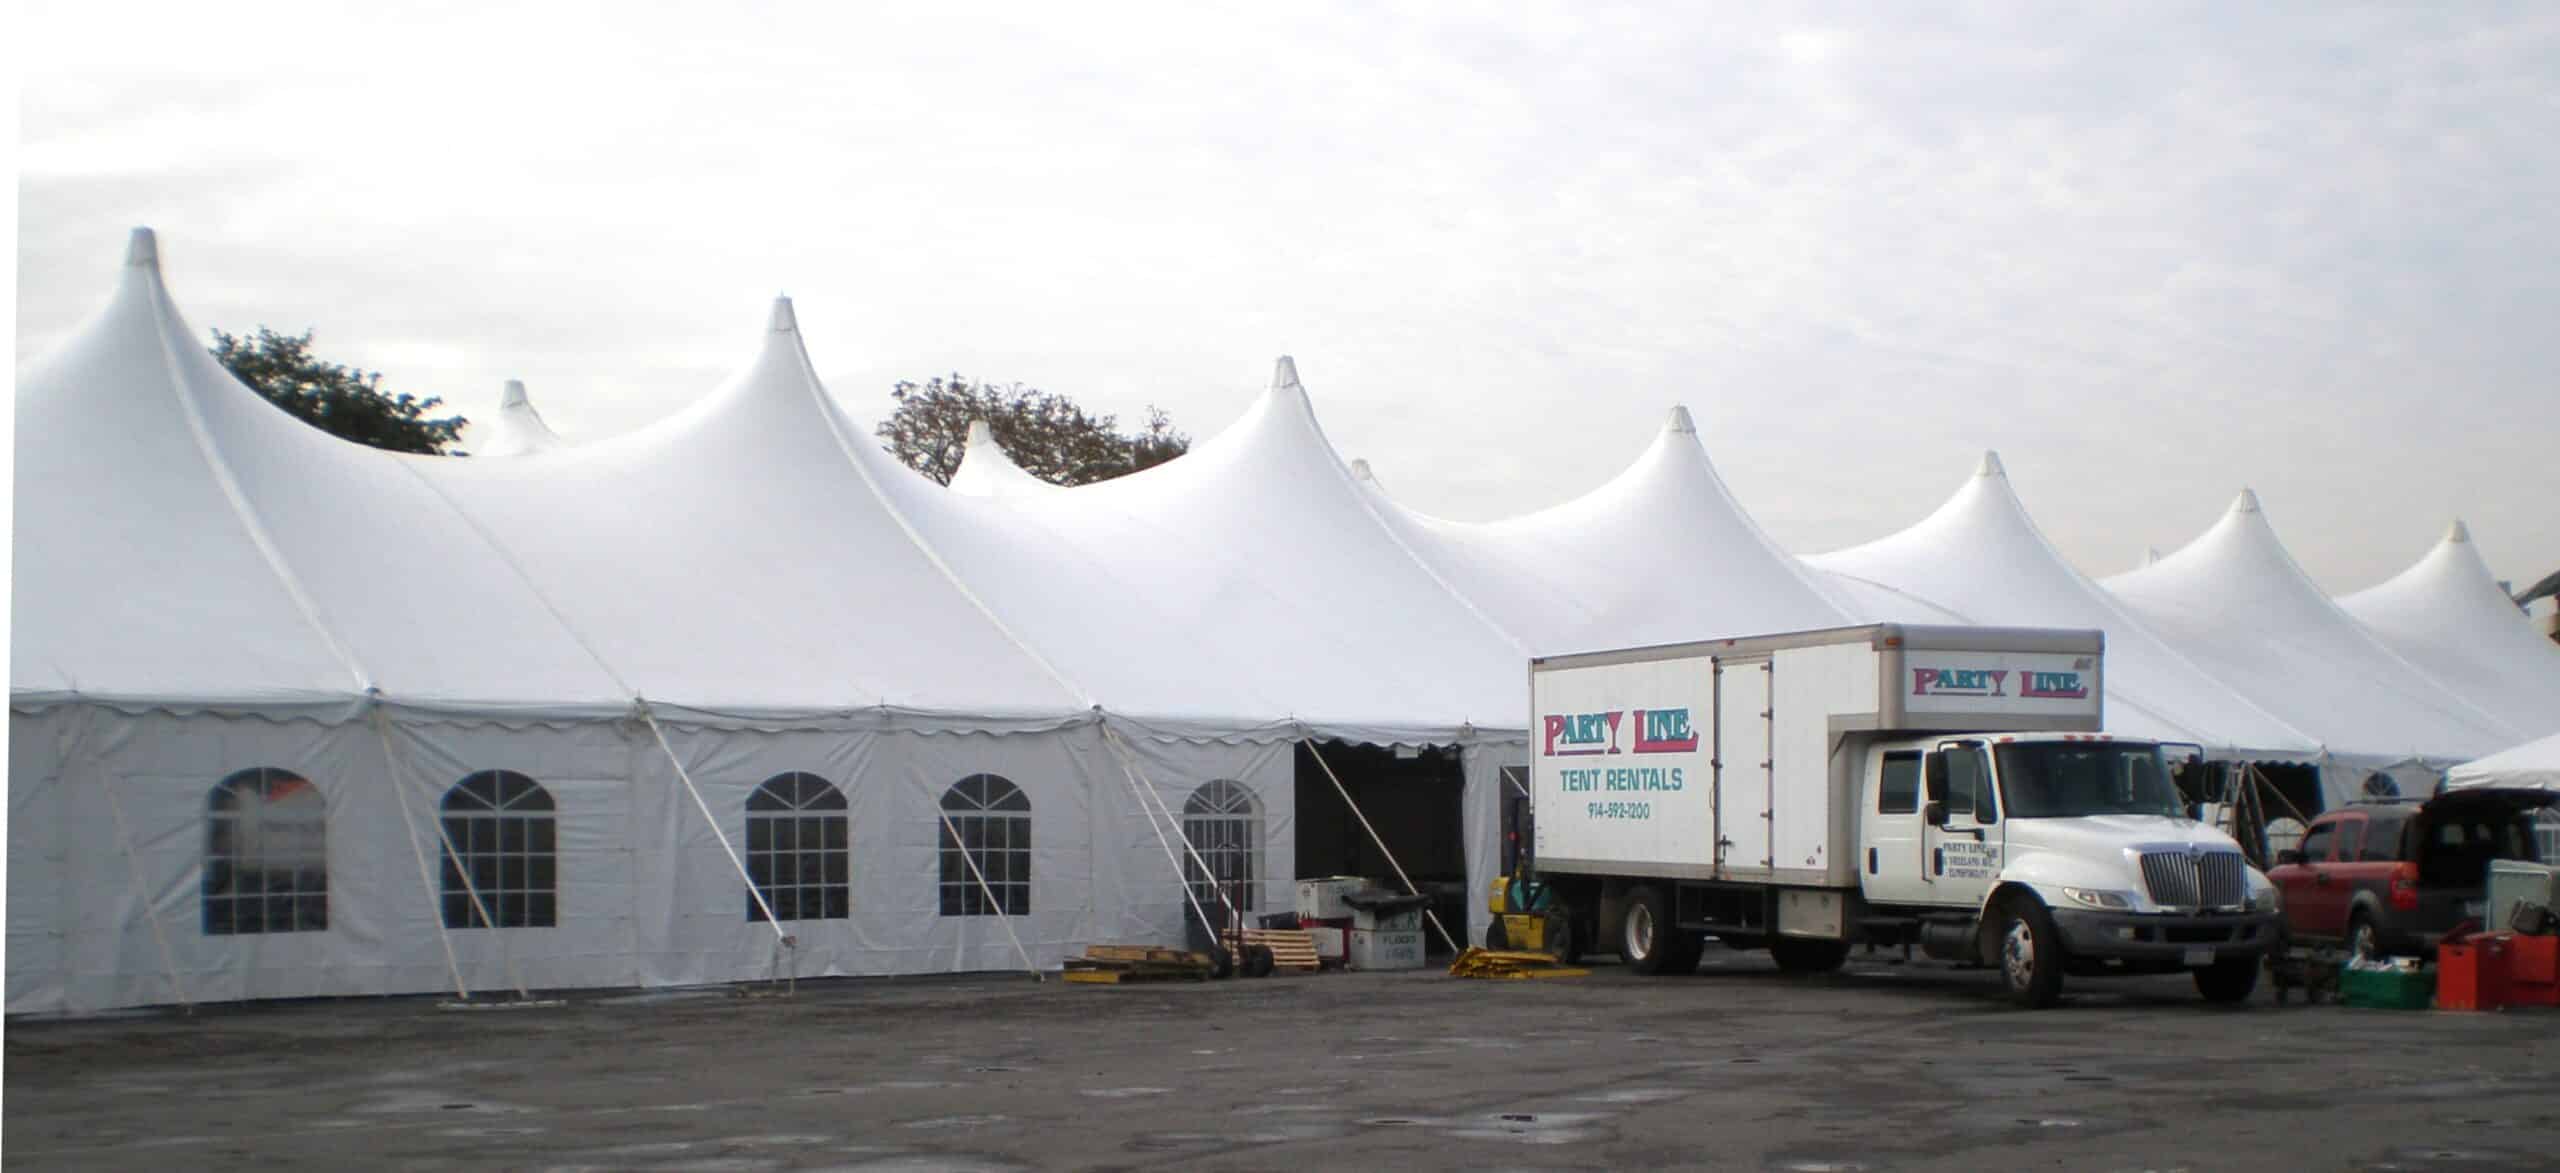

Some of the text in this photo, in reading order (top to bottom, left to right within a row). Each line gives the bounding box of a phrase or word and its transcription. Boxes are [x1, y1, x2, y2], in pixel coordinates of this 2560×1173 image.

[1912, 668, 2089, 699] PARTY LINE
[1544, 708, 1699, 756] PARTY LINE
[1560, 767, 1683, 792] TENT RENTALS
[1587, 802, 1650, 820] 914-592-1200
